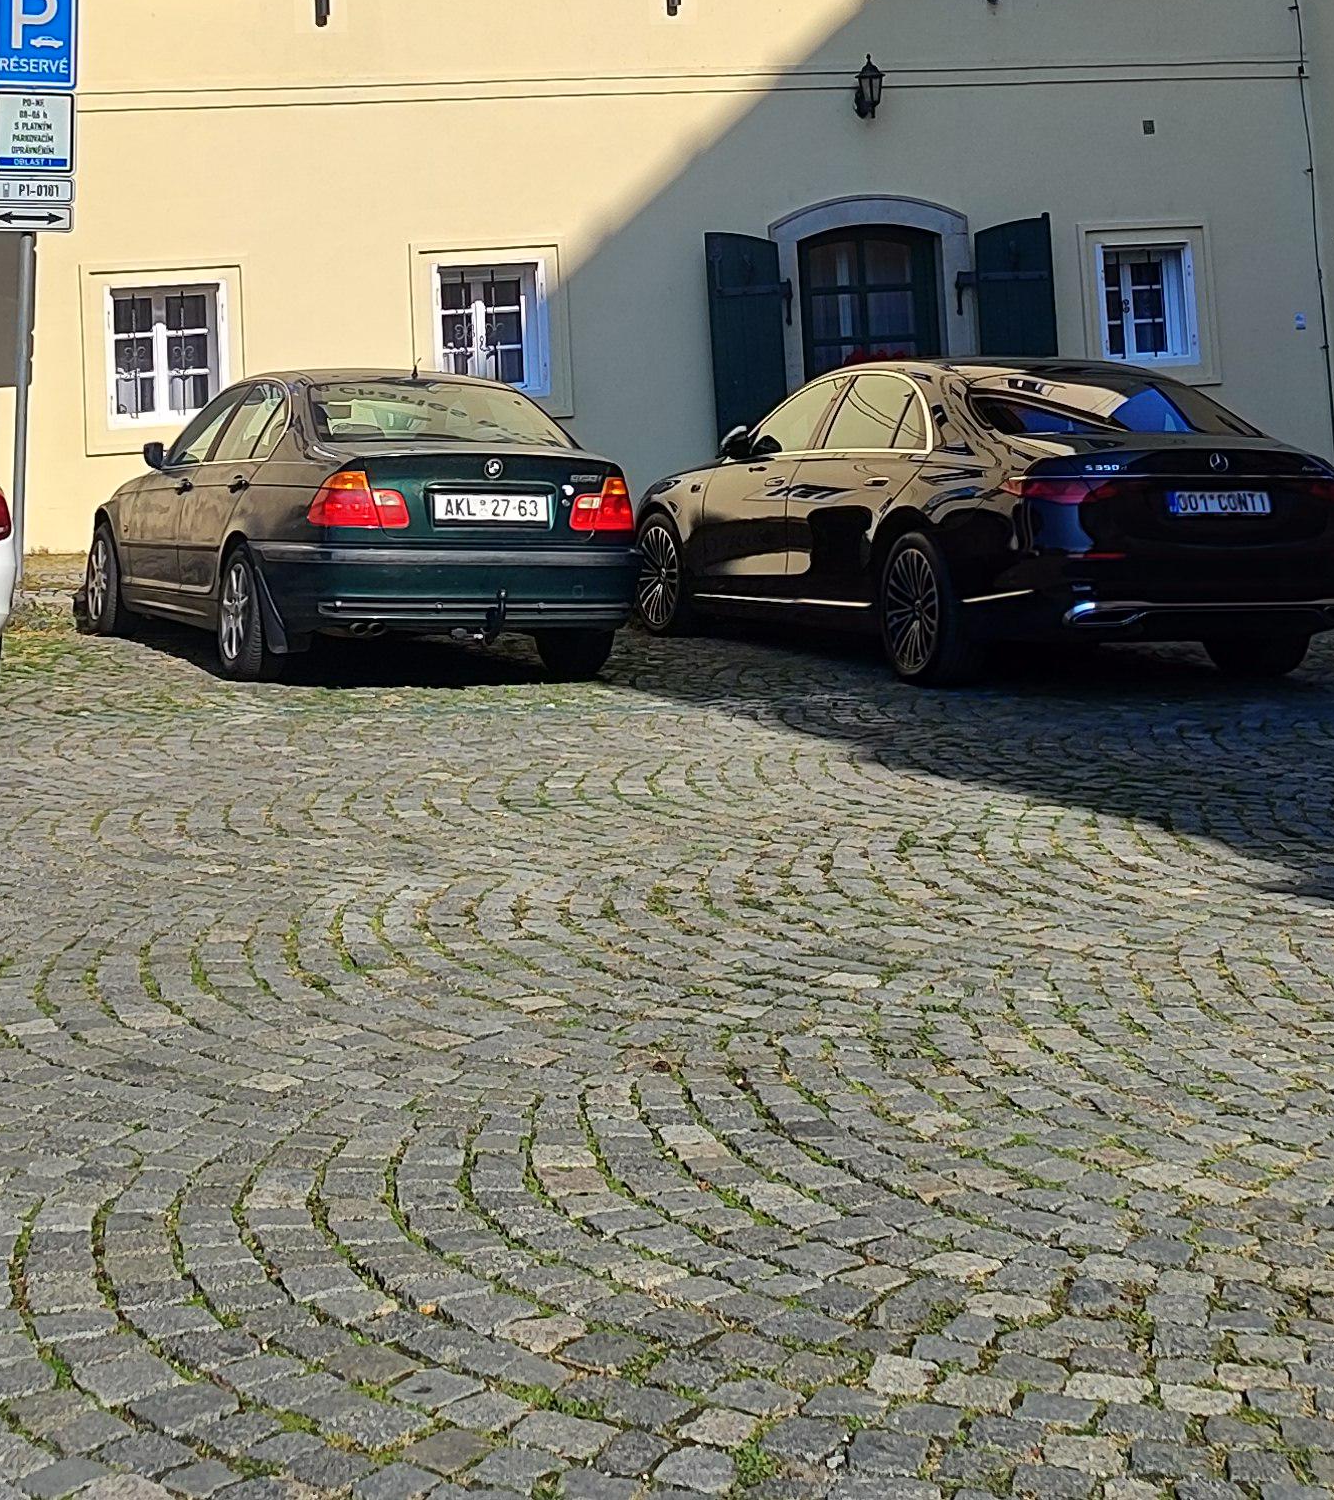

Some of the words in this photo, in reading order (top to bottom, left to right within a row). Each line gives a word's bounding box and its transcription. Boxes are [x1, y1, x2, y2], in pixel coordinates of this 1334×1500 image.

[0, 55, 69, 74] RÉSERVÉ
[14, 121, 19, 130] S
[13, 158, 45, 167] OBLAST
[444, 498, 476, 516] AKL
[1218, 493, 1267, 511] CONTI
